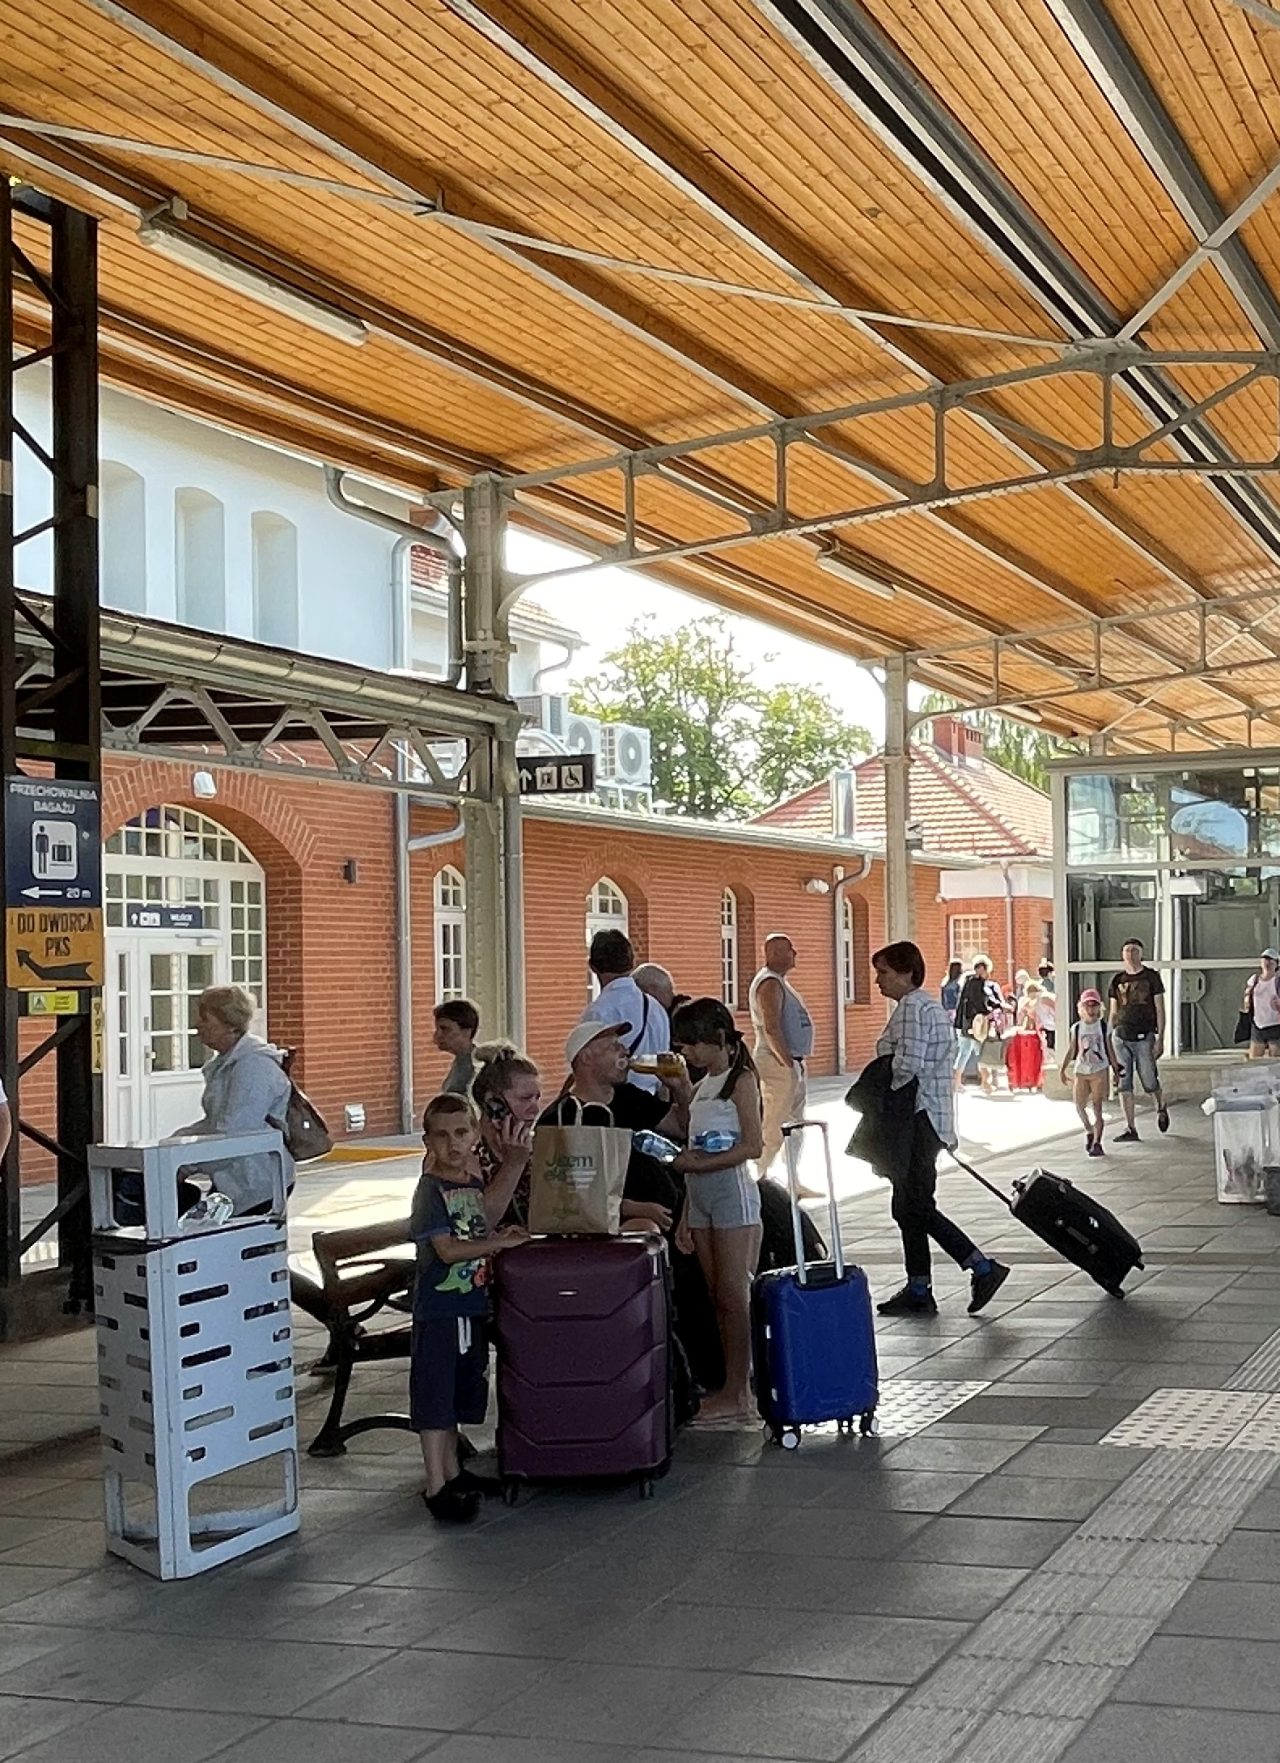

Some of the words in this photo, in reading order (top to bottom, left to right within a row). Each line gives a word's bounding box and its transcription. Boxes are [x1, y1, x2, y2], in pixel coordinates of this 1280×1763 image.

[9, 783, 97, 801] PRZECHOWALNIA
[33, 800, 76, 814] BAGAŻU
[17, 913, 35, 934] DO
[39, 913, 95, 933] DWORCA
[45, 937, 71, 957] PKS
